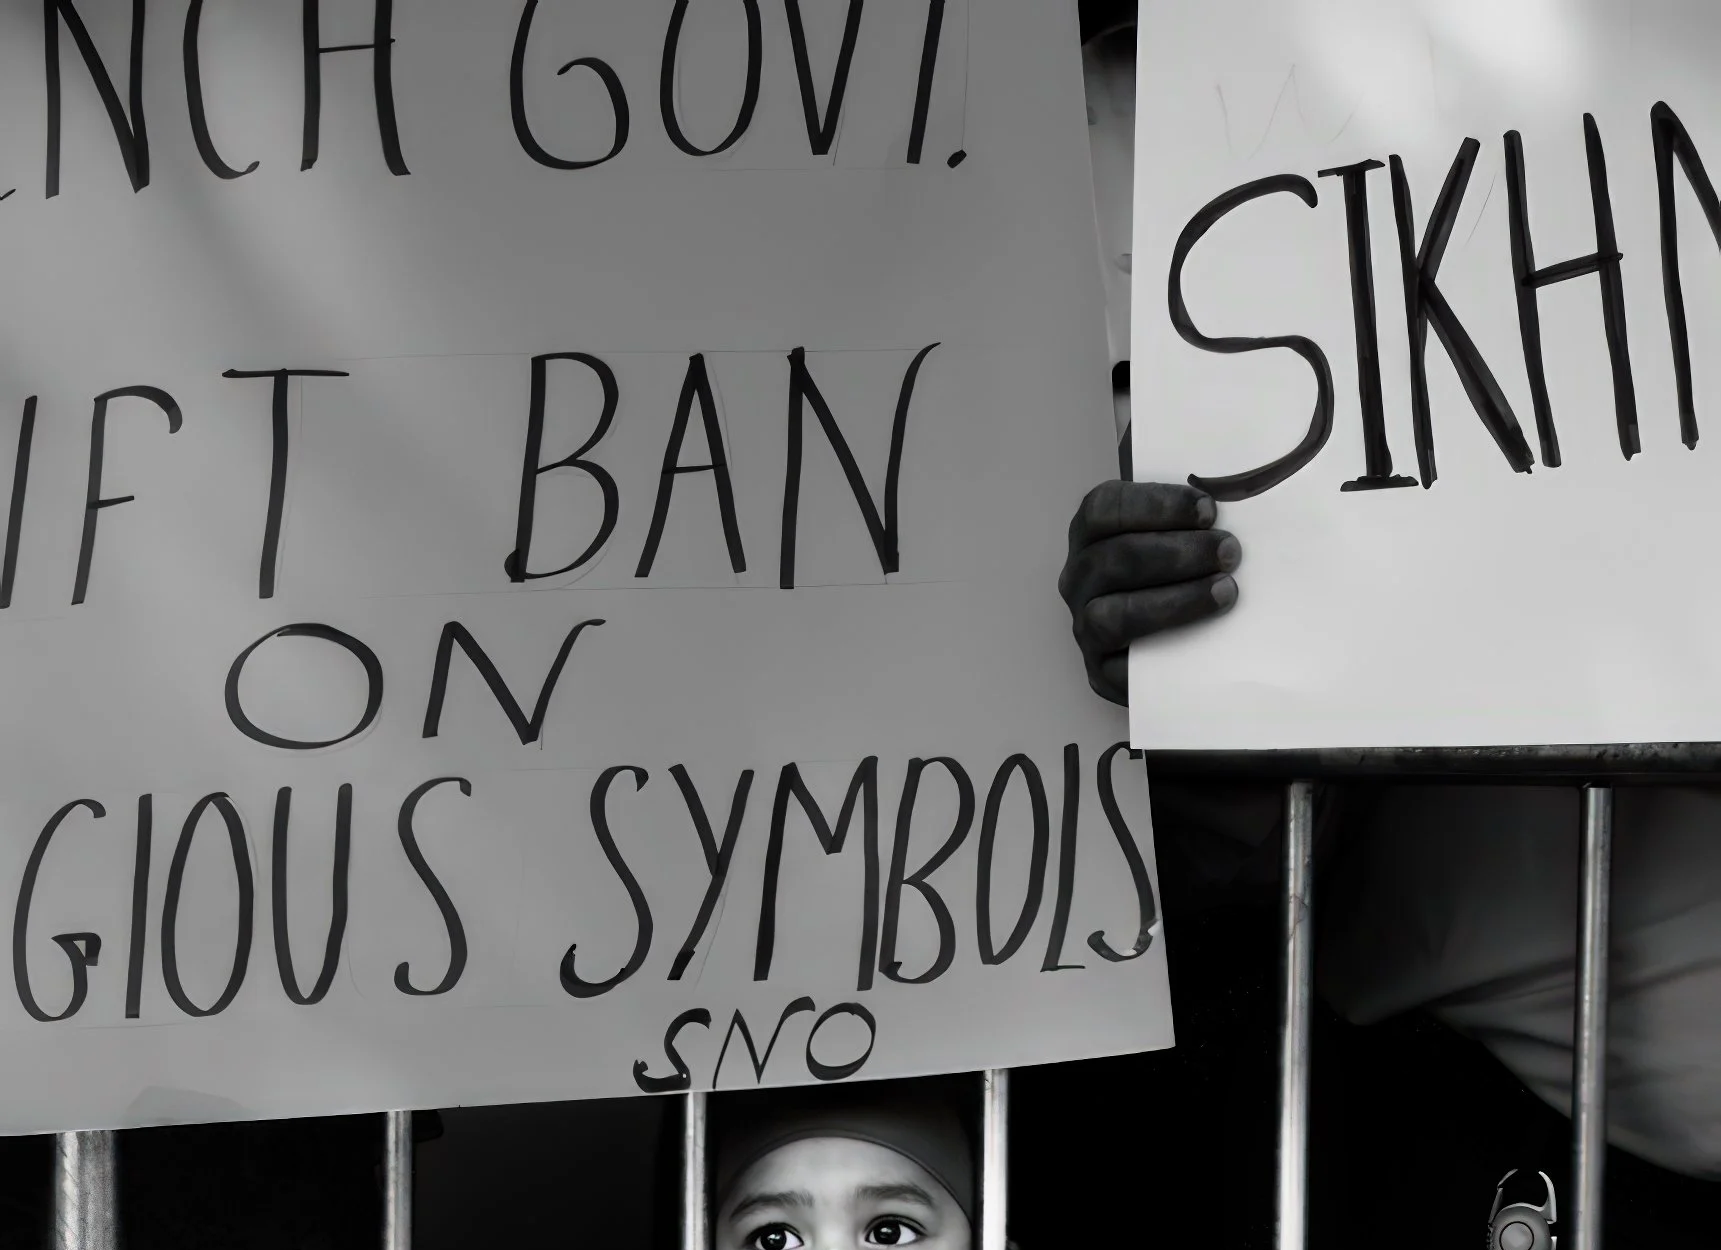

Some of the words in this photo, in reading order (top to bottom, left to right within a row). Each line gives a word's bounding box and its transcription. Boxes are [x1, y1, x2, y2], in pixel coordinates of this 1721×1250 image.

[0, 0, 411, 200] NCH
[504, 342, 941, 590] BAN
[224, 622, 606, 750] ON
[13, 776, 472, 1022] GIOUS
[559, 740, 1158, 999] SYMBOLS
